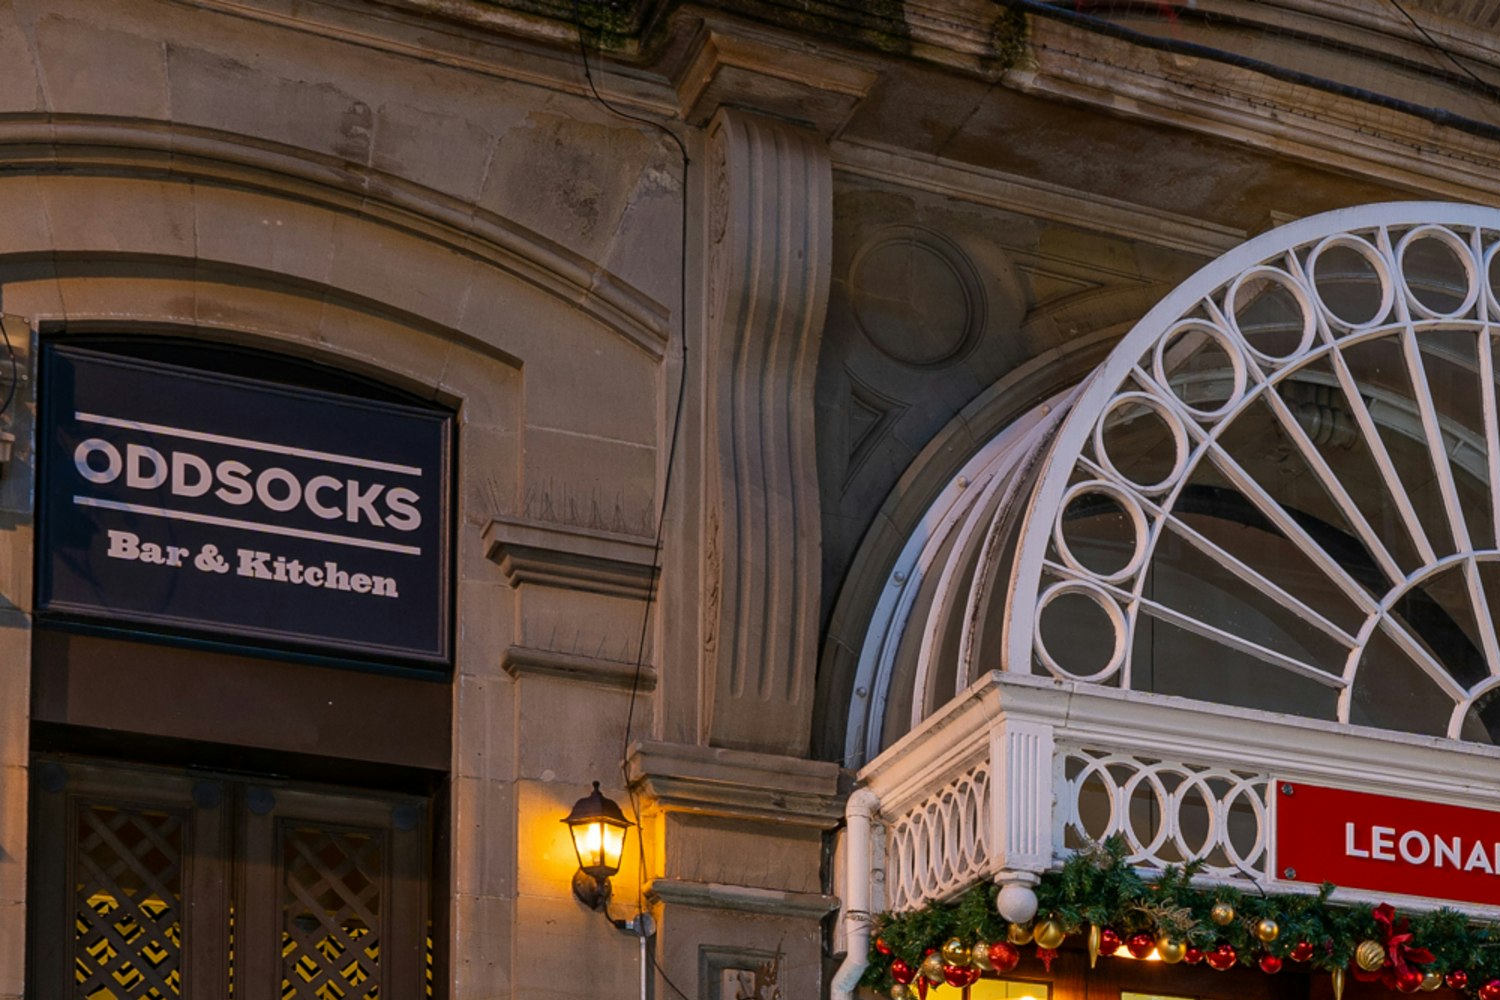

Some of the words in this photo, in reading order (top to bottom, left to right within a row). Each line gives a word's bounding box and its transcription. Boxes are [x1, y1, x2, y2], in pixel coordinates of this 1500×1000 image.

[74, 438, 422, 531] ODDSOCKS
[107, 529, 189, 567] Bar
[194, 544, 230, 574] &
[237, 548, 399, 598] Kitchen
